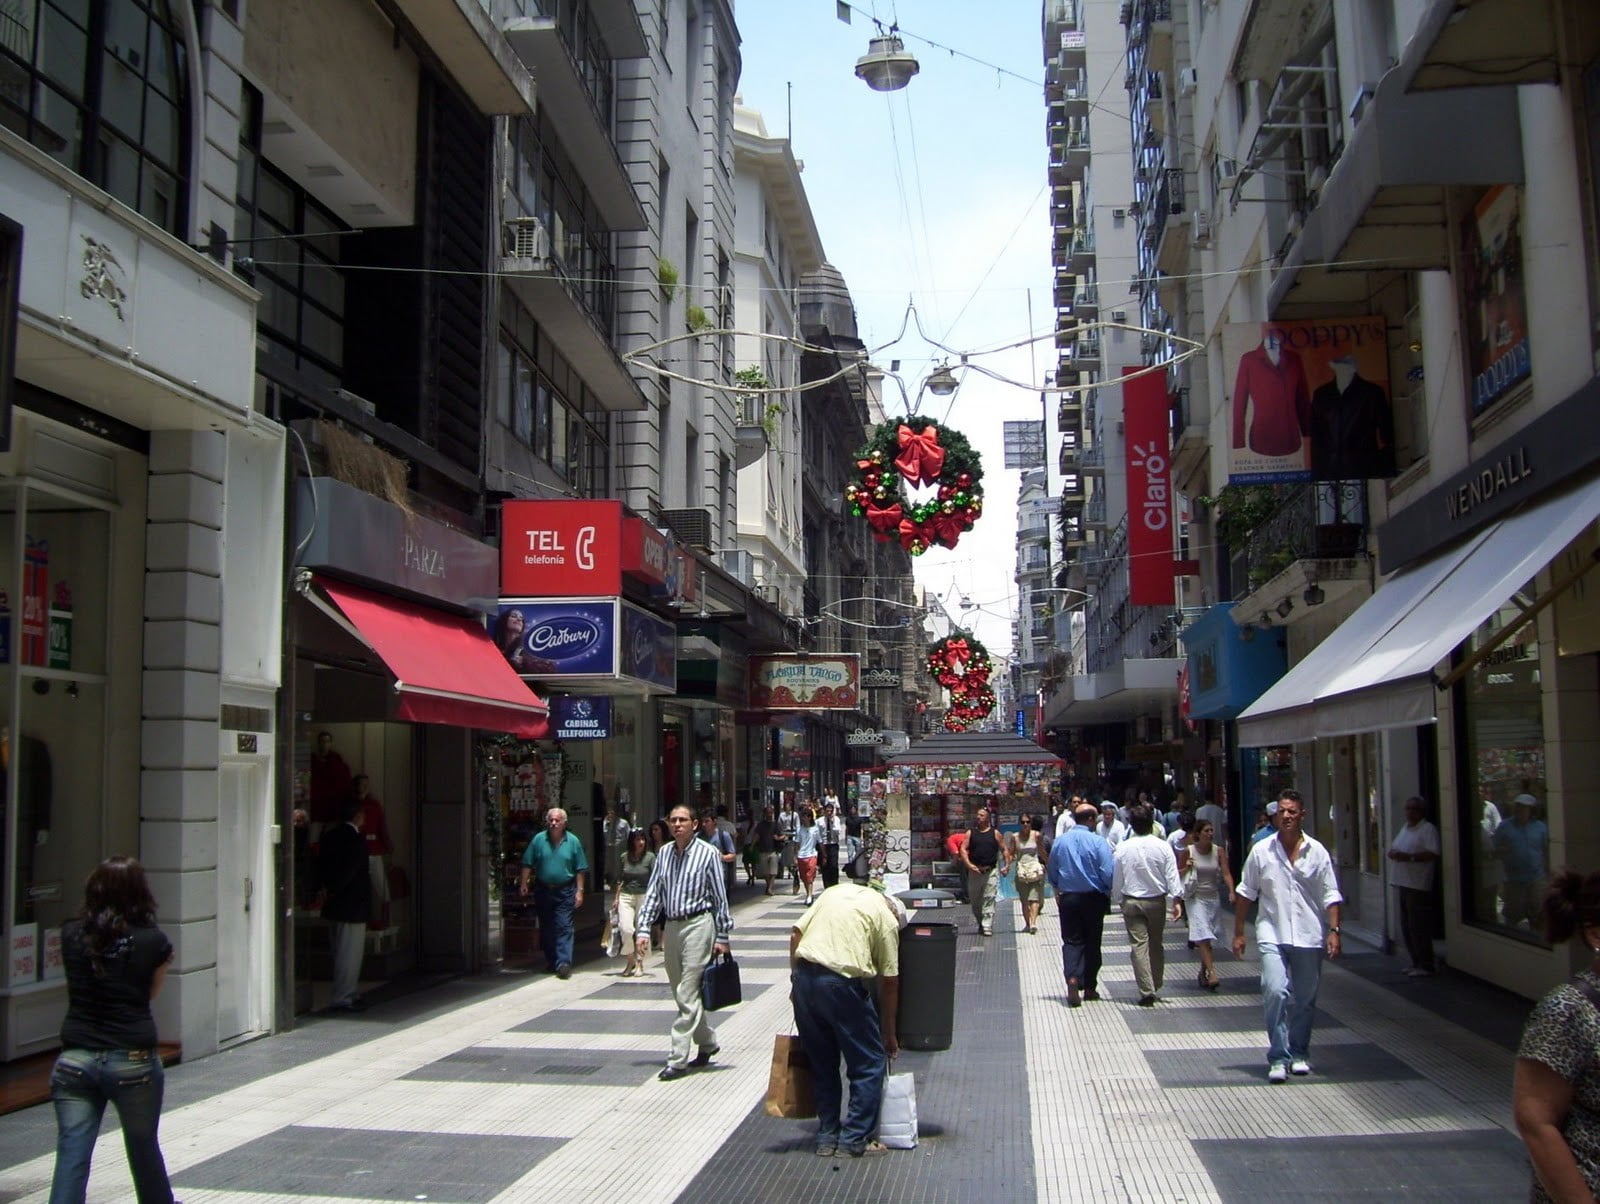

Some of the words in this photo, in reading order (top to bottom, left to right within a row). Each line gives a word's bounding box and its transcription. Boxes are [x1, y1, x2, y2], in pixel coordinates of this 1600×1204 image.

[1143, 454, 1168, 531] Claro
[1446, 447, 1532, 520] WENDALL
[526, 530, 565, 551] TEL
[404, 535, 446, 579] PARZA
[525, 554, 565, 565] telefonía
[528, 624, 591, 652] Cadbury
[557, 729, 607, 738] TELEFONICAS
[564, 719, 599, 728] CABINAS
